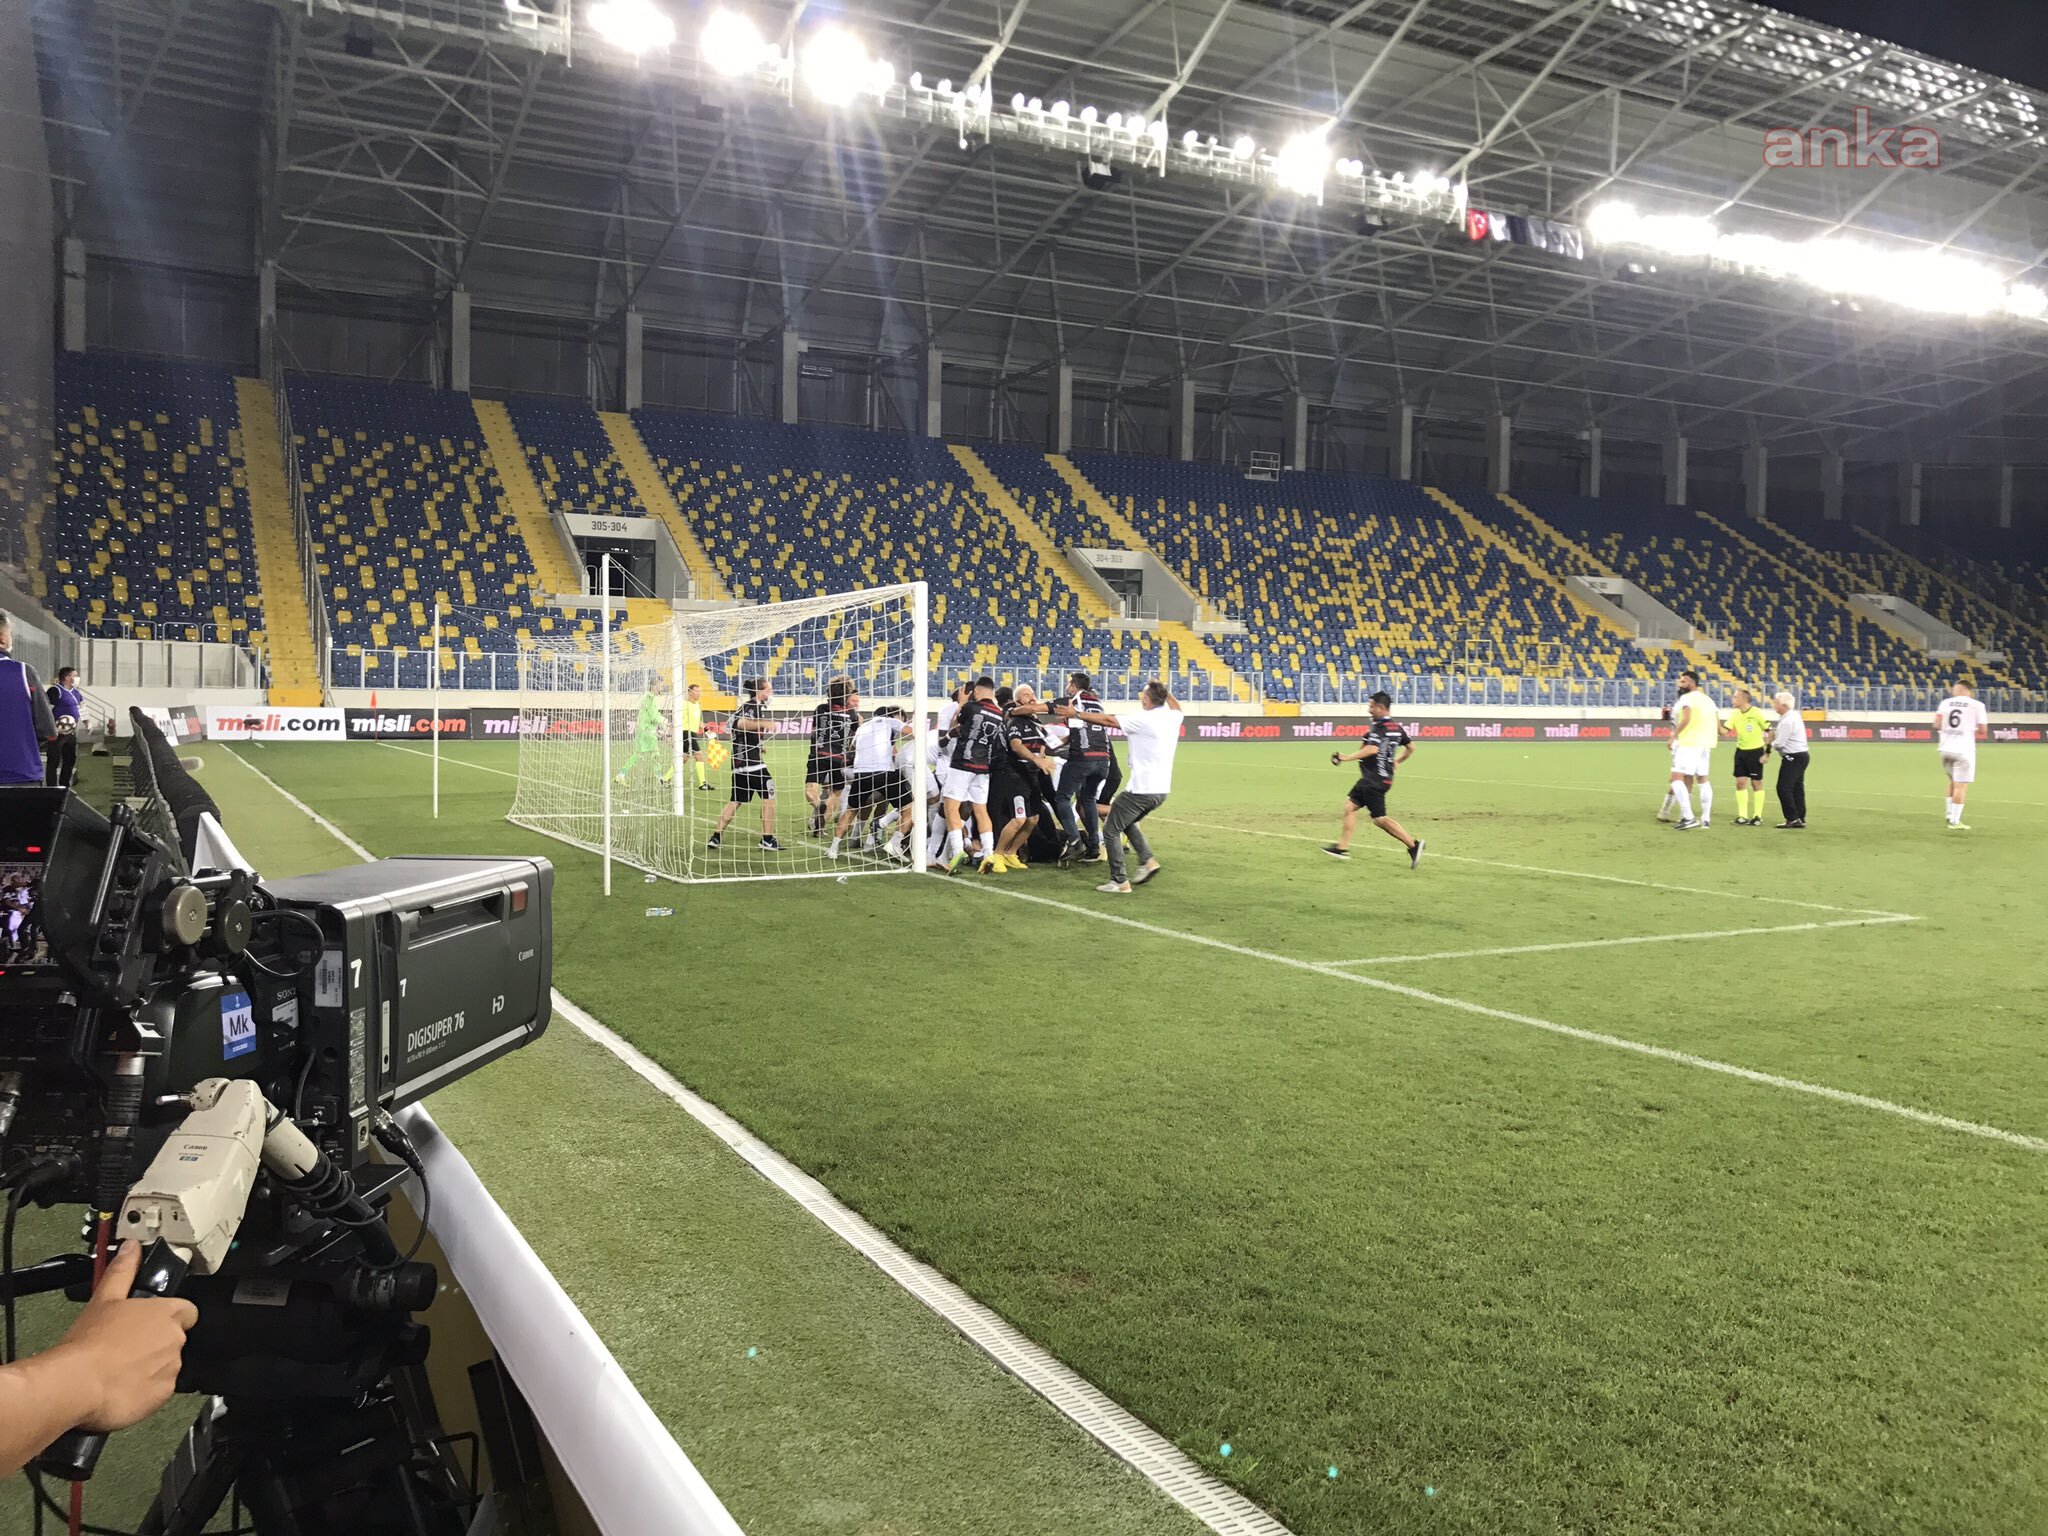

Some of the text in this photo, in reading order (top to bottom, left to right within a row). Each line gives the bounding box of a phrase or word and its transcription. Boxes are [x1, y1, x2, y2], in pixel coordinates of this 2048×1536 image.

[591, 521, 628, 532] 305-304
[216, 714, 341, 731] misli.com
[351, 714, 467, 732] misli.com
[1949, 709, 1962, 729] 6
[1198, 721, 1281, 738] misli.com
[1464, 723, 1536, 738] misli.com
[1544, 723, 1611, 738] misli.com
[350, 958, 363, 989] 7
[276, 986, 297, 1001] SONY
[400, 978, 408, 998] 7
[491, 994, 505, 1015] HD
[229, 1013, 250, 1037] Mk
[407, 1016, 453, 1053] DIGISUPER
[454, 1010, 465, 1032] 76
